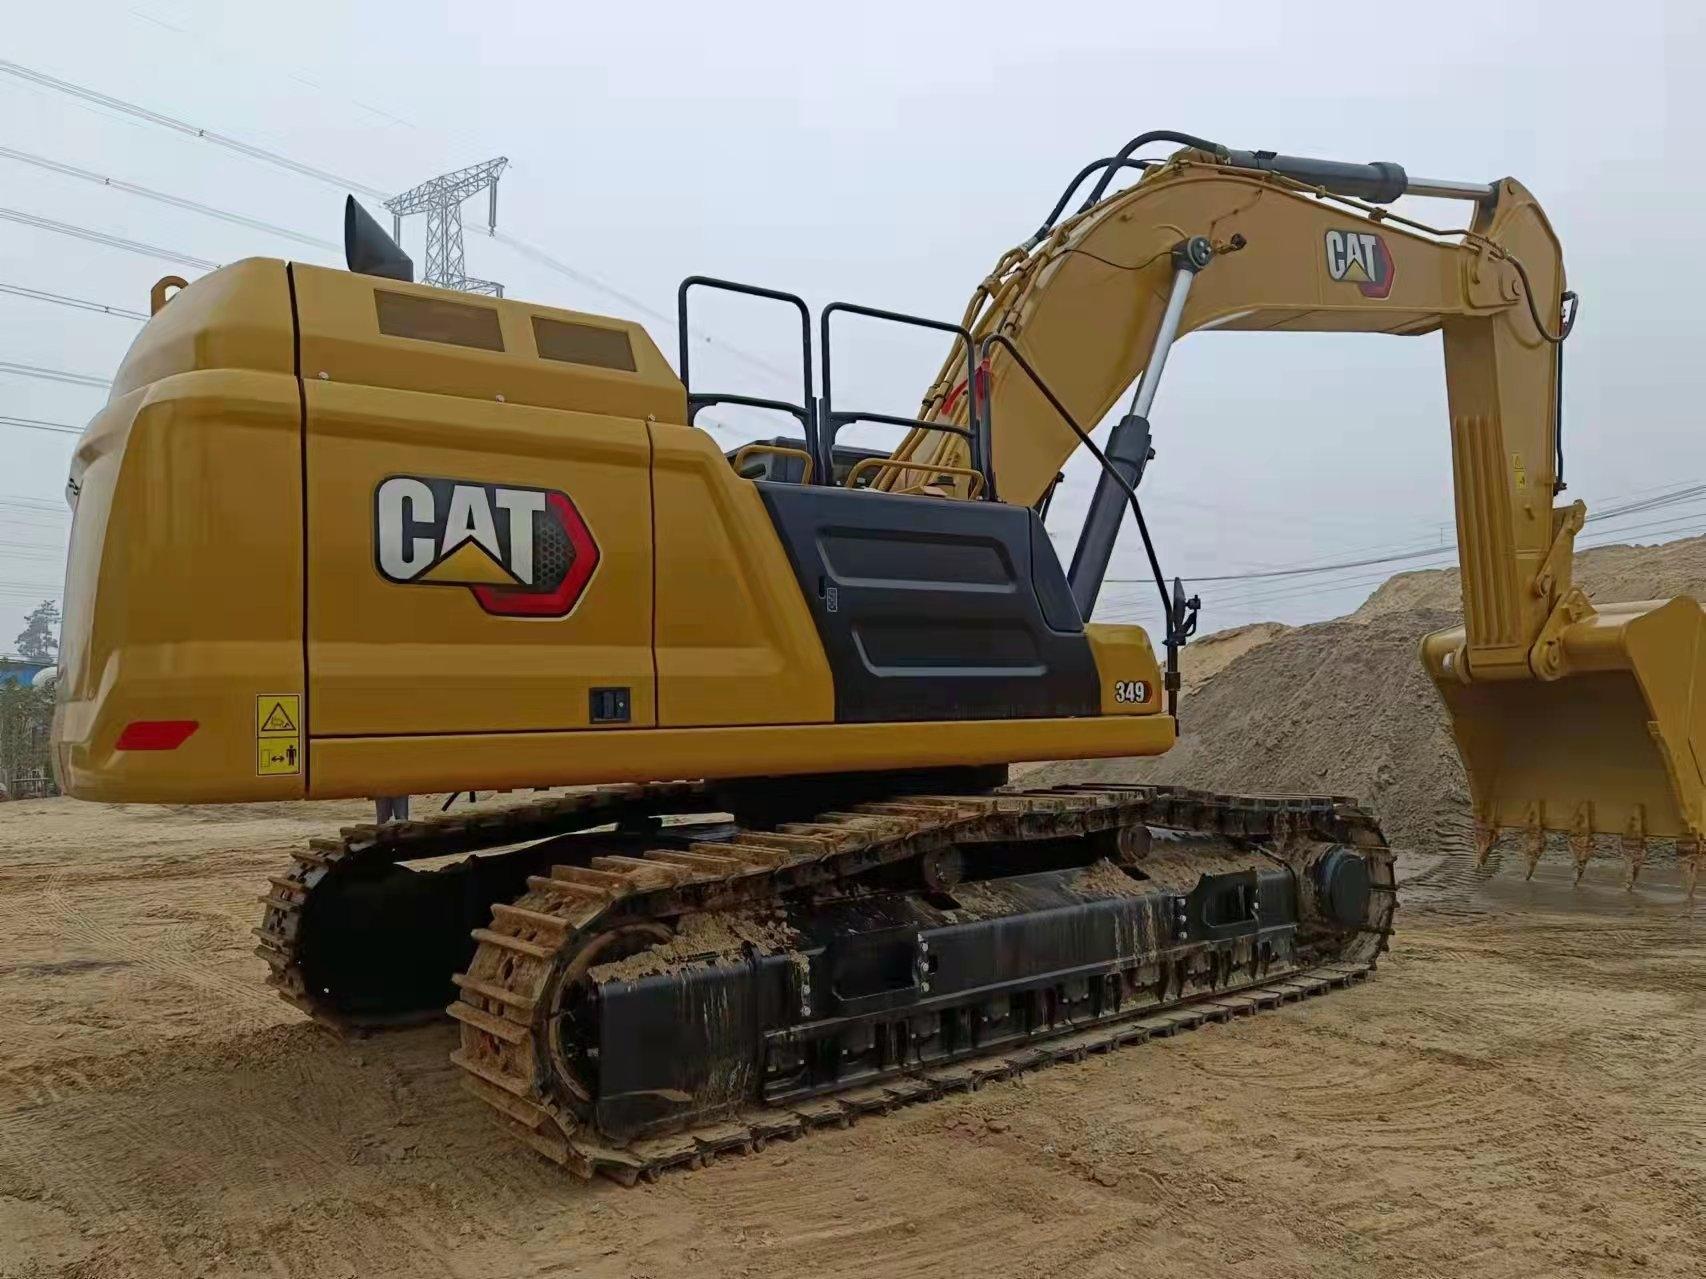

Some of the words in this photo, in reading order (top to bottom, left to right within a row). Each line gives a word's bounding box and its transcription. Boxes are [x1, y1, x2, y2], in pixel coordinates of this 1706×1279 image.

[1325, 230, 1376, 282] CAT
[378, 478, 546, 585] CAT
[1115, 681, 1145, 703] 349
